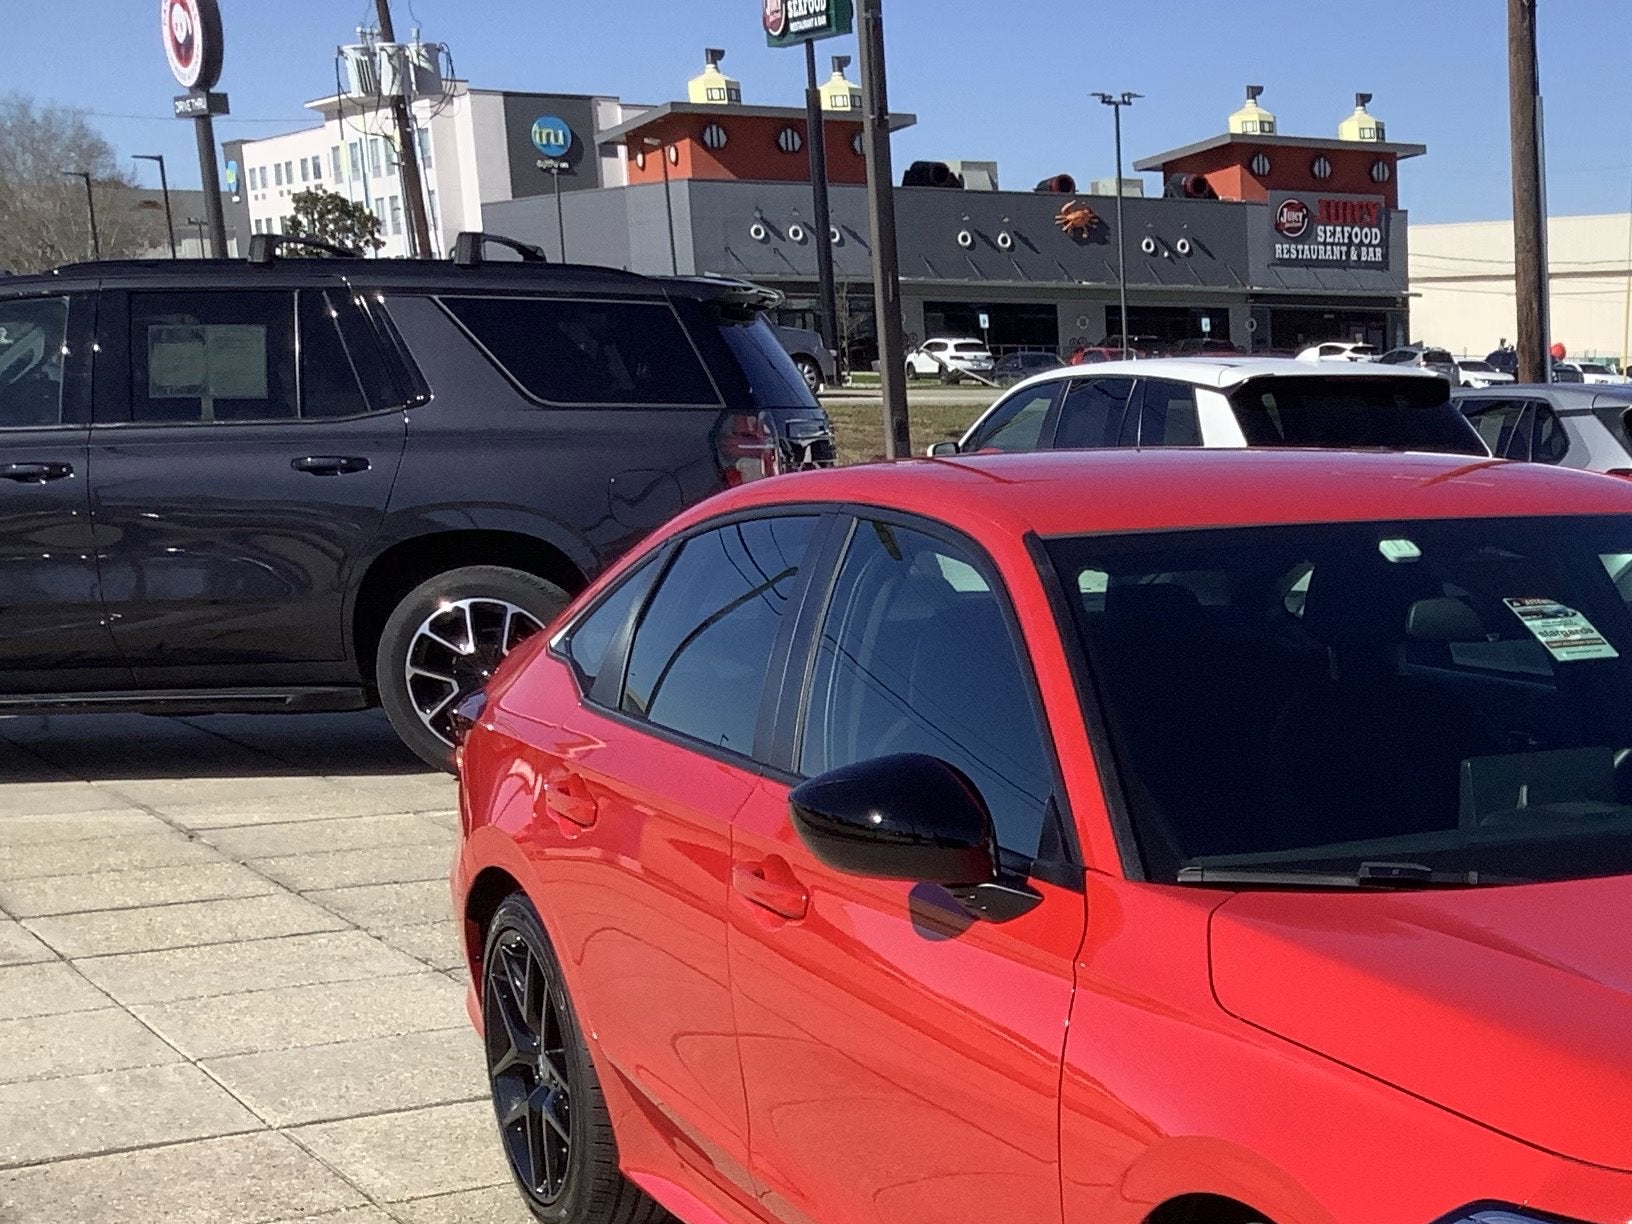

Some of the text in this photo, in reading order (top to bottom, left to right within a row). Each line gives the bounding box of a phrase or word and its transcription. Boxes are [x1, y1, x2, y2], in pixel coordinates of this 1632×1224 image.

[787, 0, 827, 18] SEAFOOD
[1313, 199, 1378, 226] JUICY
[1317, 225, 1381, 245] SEAFOOD
[1274, 243, 1382, 262] RESTAURANT & BAR
